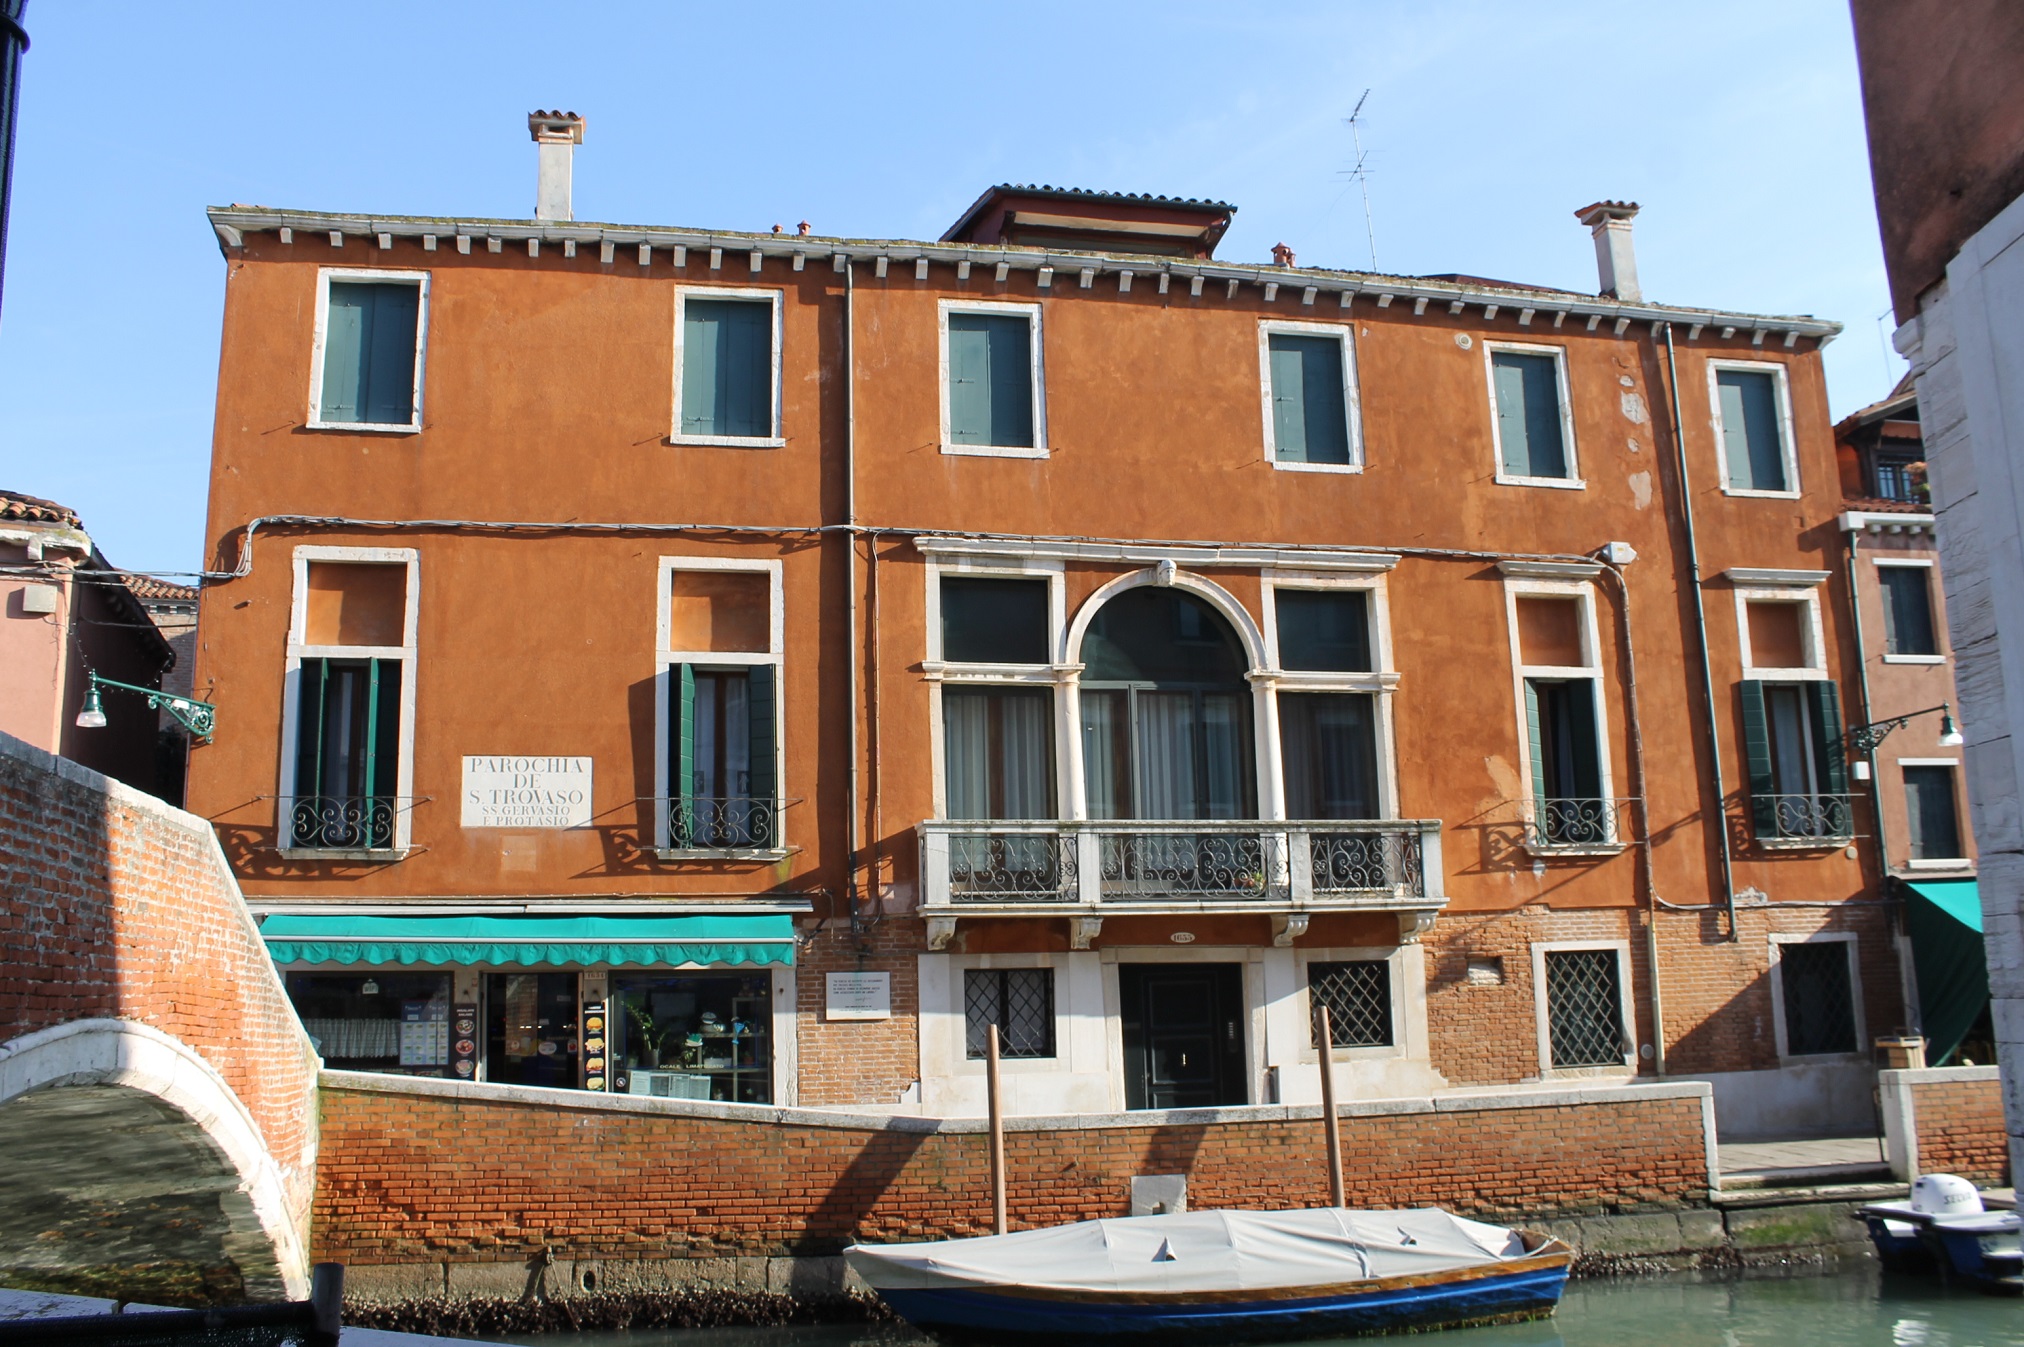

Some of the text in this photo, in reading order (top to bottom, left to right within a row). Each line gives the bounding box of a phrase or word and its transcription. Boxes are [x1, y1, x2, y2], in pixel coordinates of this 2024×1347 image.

[471, 758, 583, 773] PAROCHIA
[514, 774, 541, 788] DE
[470, 790, 583, 804] S. TROVASO
[502, 806, 570, 815] GERVASIO
[483, 816, 569, 825] E PROTASIO
